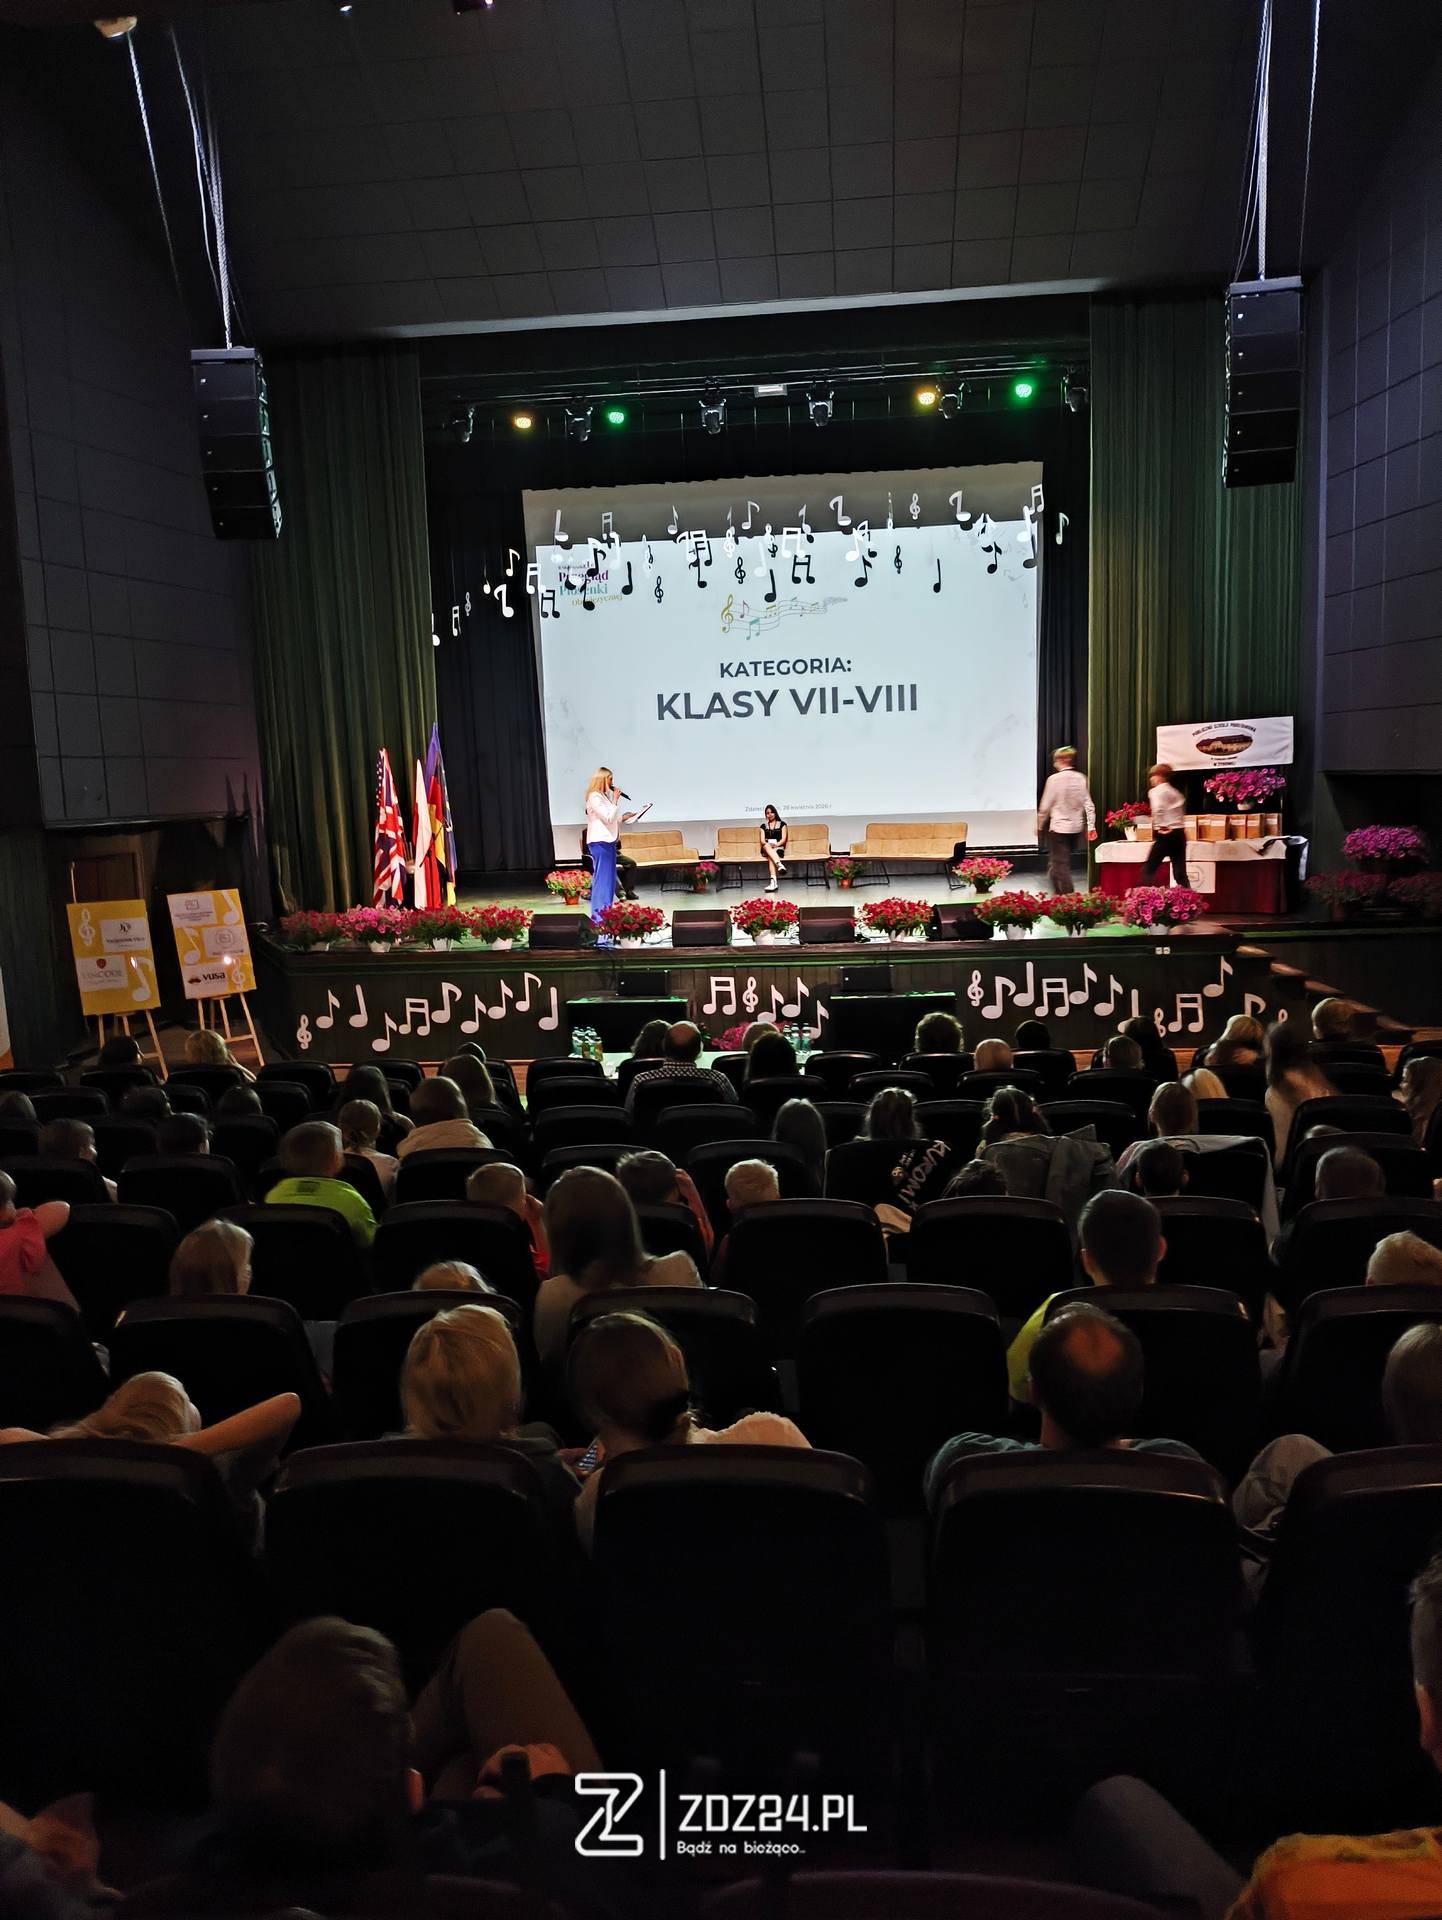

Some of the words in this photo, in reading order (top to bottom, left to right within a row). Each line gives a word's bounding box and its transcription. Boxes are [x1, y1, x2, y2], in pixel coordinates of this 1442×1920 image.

[719, 656, 853, 680] KATEGORIA:
[656, 688, 779, 721] KLASY
[789, 683, 919, 716] VII-VIII
